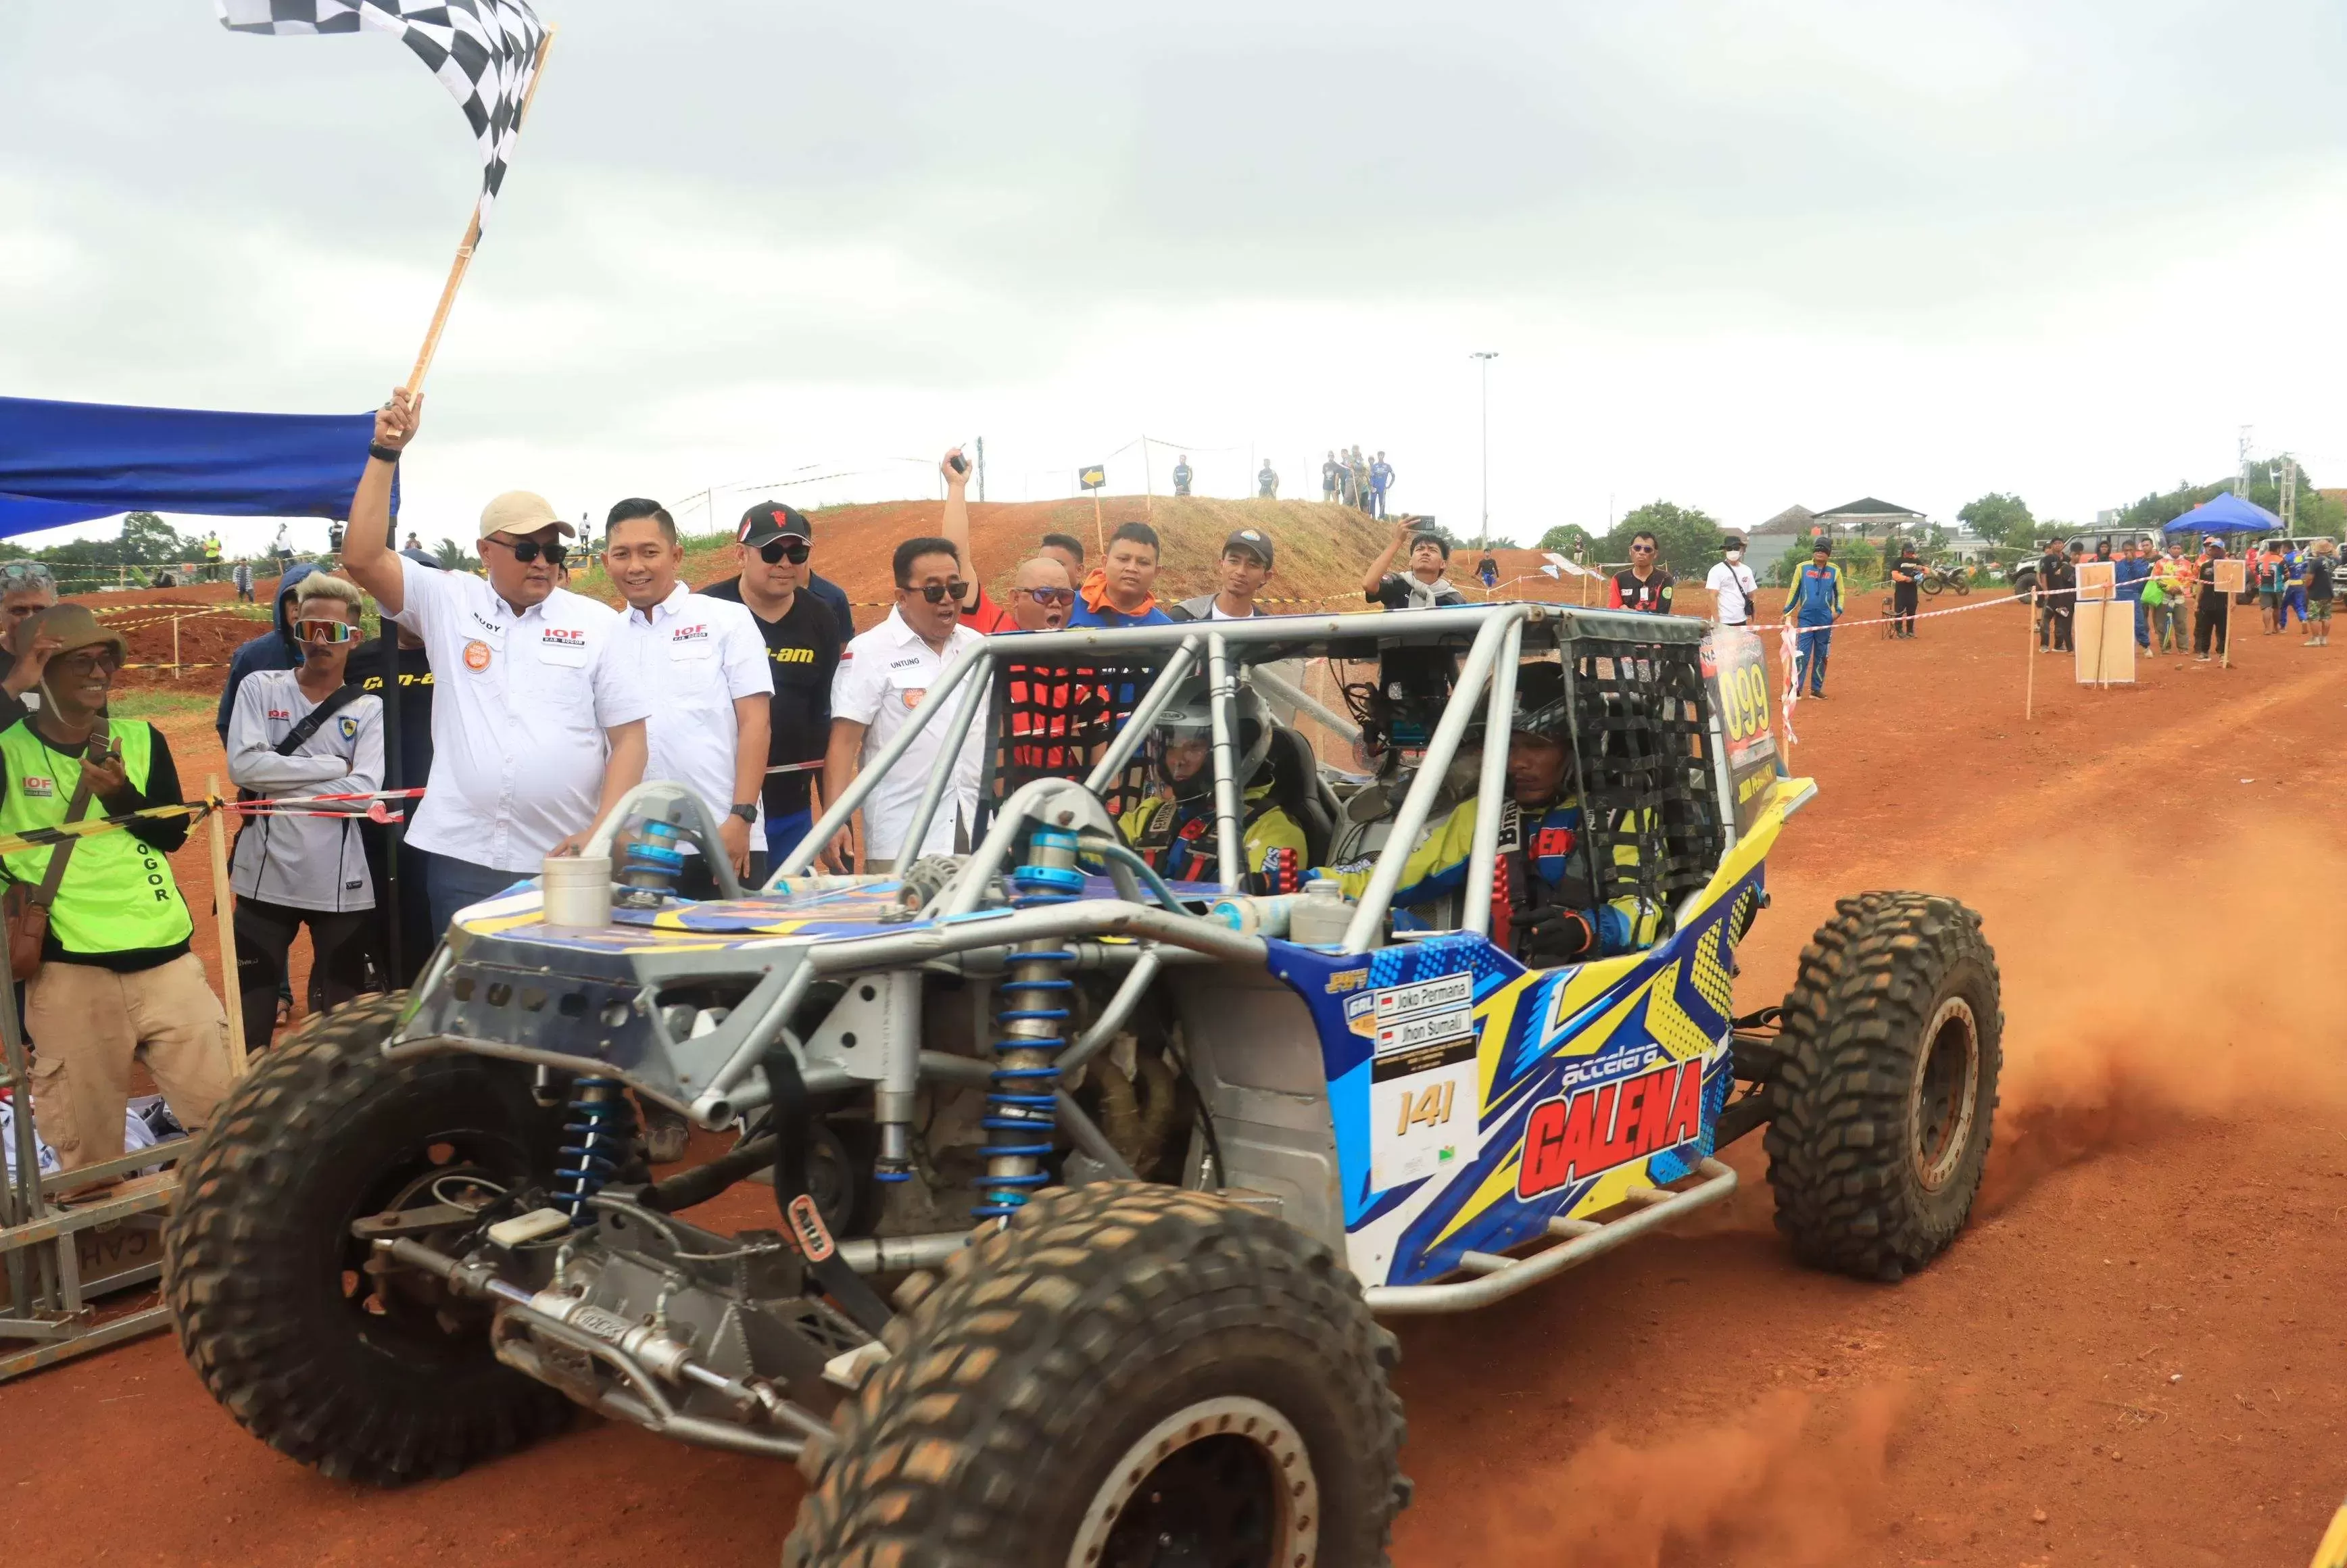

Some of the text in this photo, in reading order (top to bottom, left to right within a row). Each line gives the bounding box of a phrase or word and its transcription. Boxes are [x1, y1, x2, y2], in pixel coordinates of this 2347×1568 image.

[474, 612, 501, 633] RUDY
[675, 624, 707, 637] IOF
[545, 629, 584, 639] IOF
[765, 647, 814, 663] -am
[890, 658, 920, 669] UNTUNG
[362, 672, 434, 691] cn-a
[1719, 662, 1770, 741] 099
[268, 710, 289, 718] IOF
[22, 777, 52, 789] IOF
[137, 843, 170, 902] OGOR
[1349, 995, 1374, 1016] GAL
[1397, 982, 1466, 1010] Joko Permana
[1402, 1014, 1463, 1043] Jhon Sumali
[1562, 1042, 1658, 1086] accelera
[1398, 1079, 1456, 1136] 141
[1517, 1057, 1703, 1199] GALENA
[80, 1231, 149, 1272] CAH
